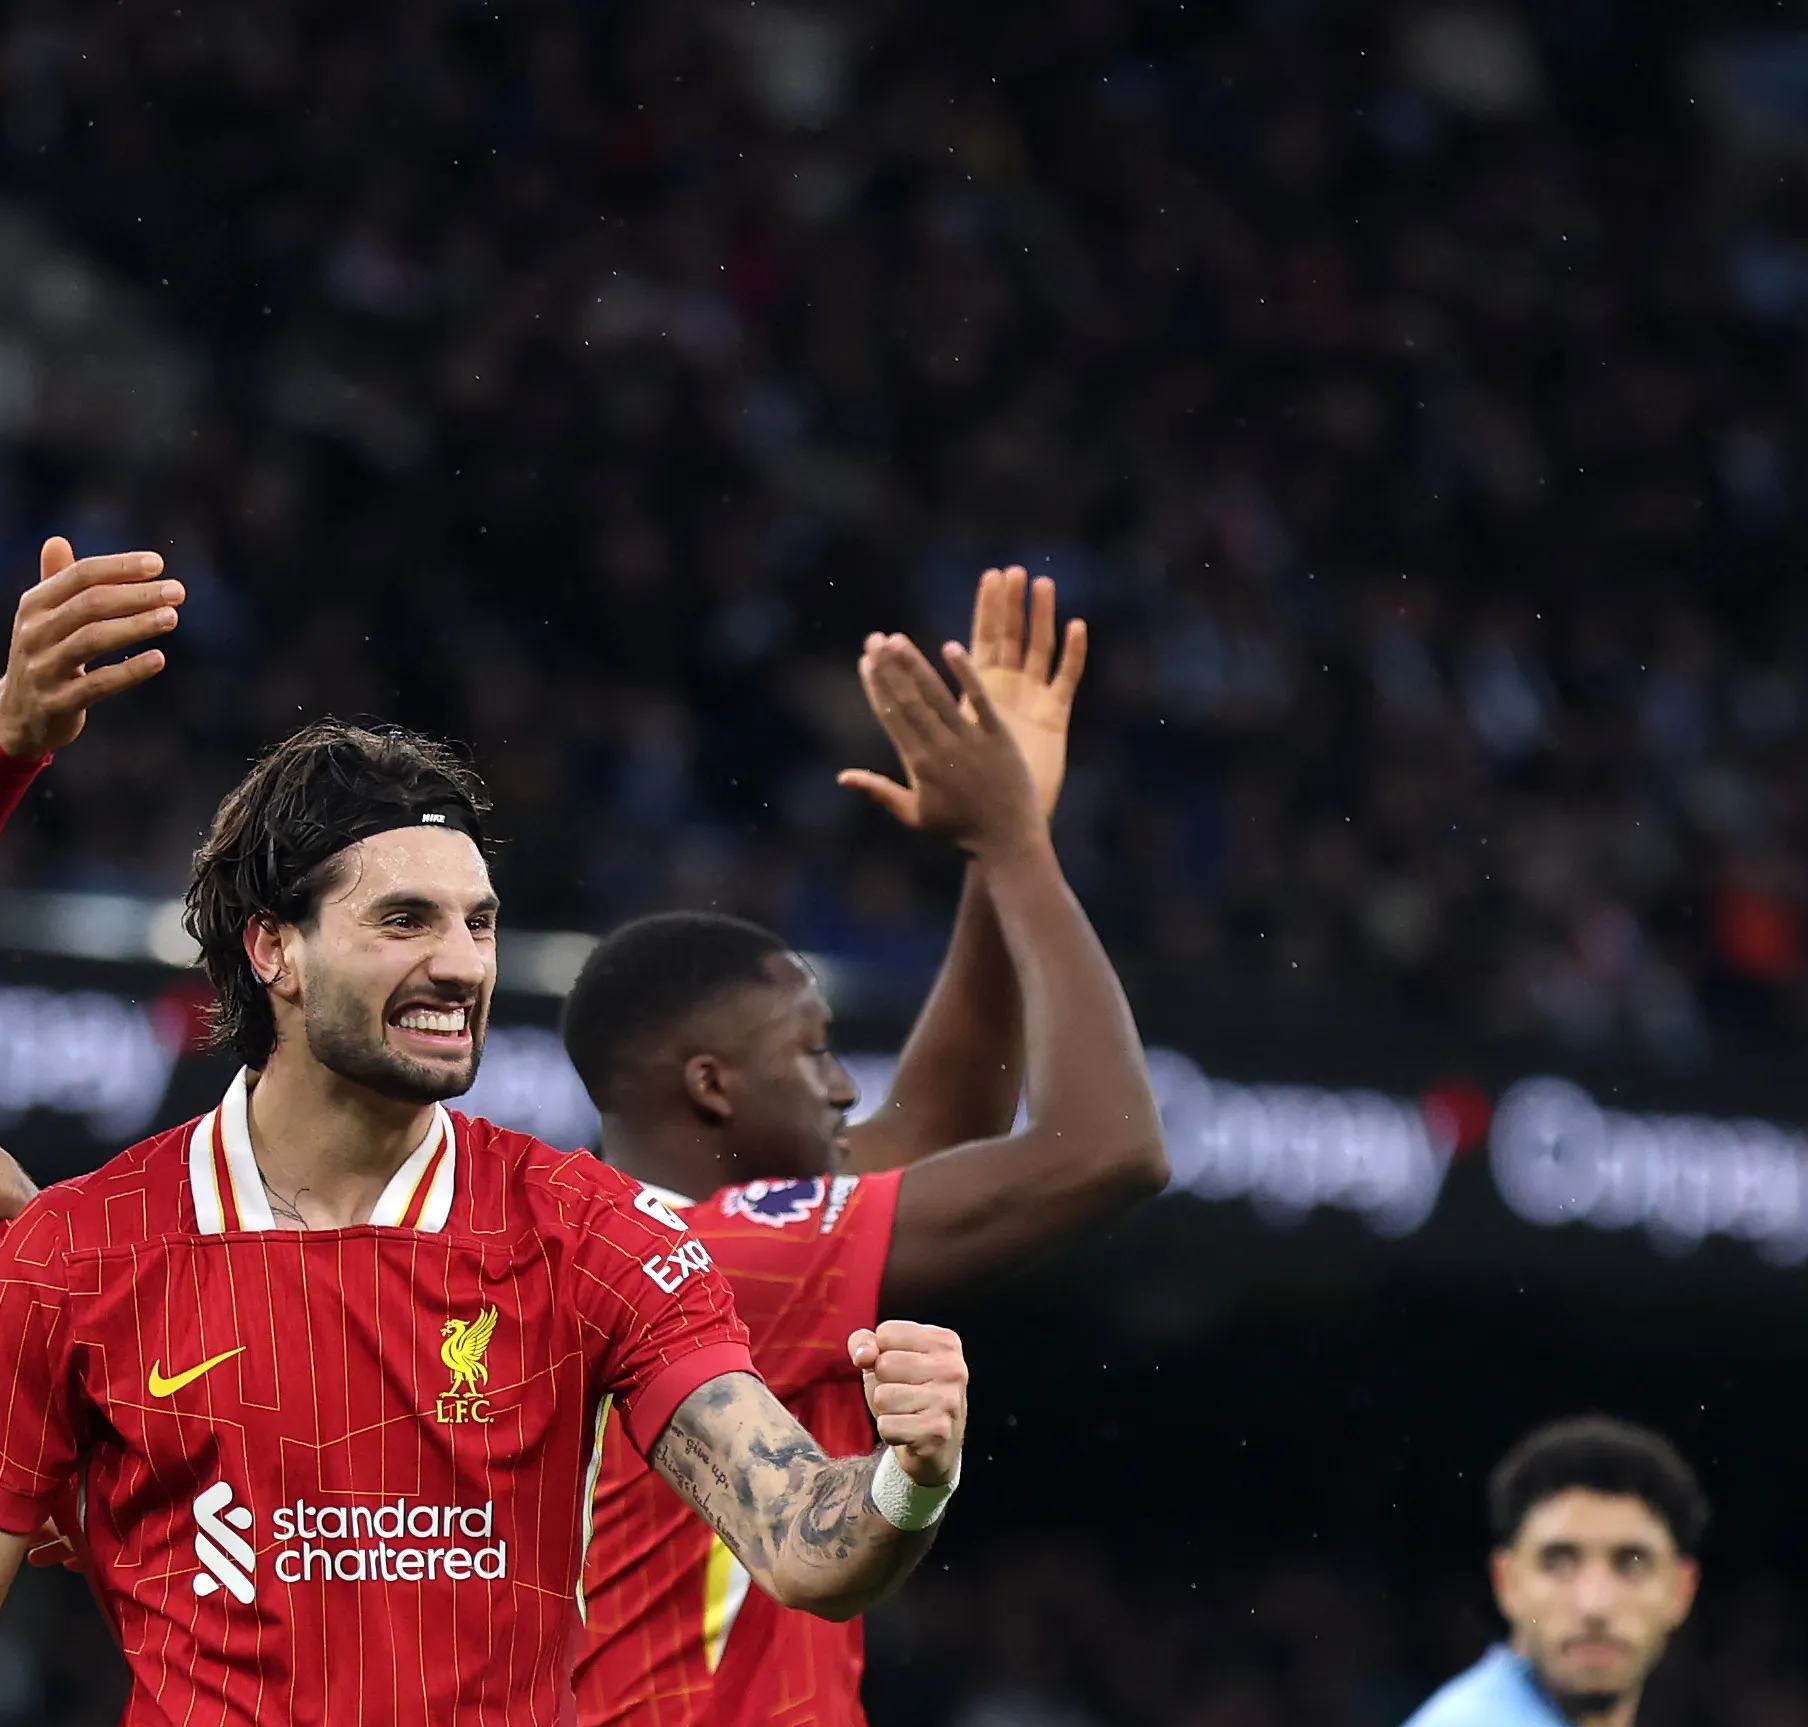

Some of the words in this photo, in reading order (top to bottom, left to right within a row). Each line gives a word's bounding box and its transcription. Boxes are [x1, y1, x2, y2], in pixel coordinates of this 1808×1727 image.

[421, 813, 446, 823] NIKE
[436, 1400, 495, 1424] L.F.C.
[273, 1498, 493, 1541] standard
[275, 1540, 507, 1583] chartered
